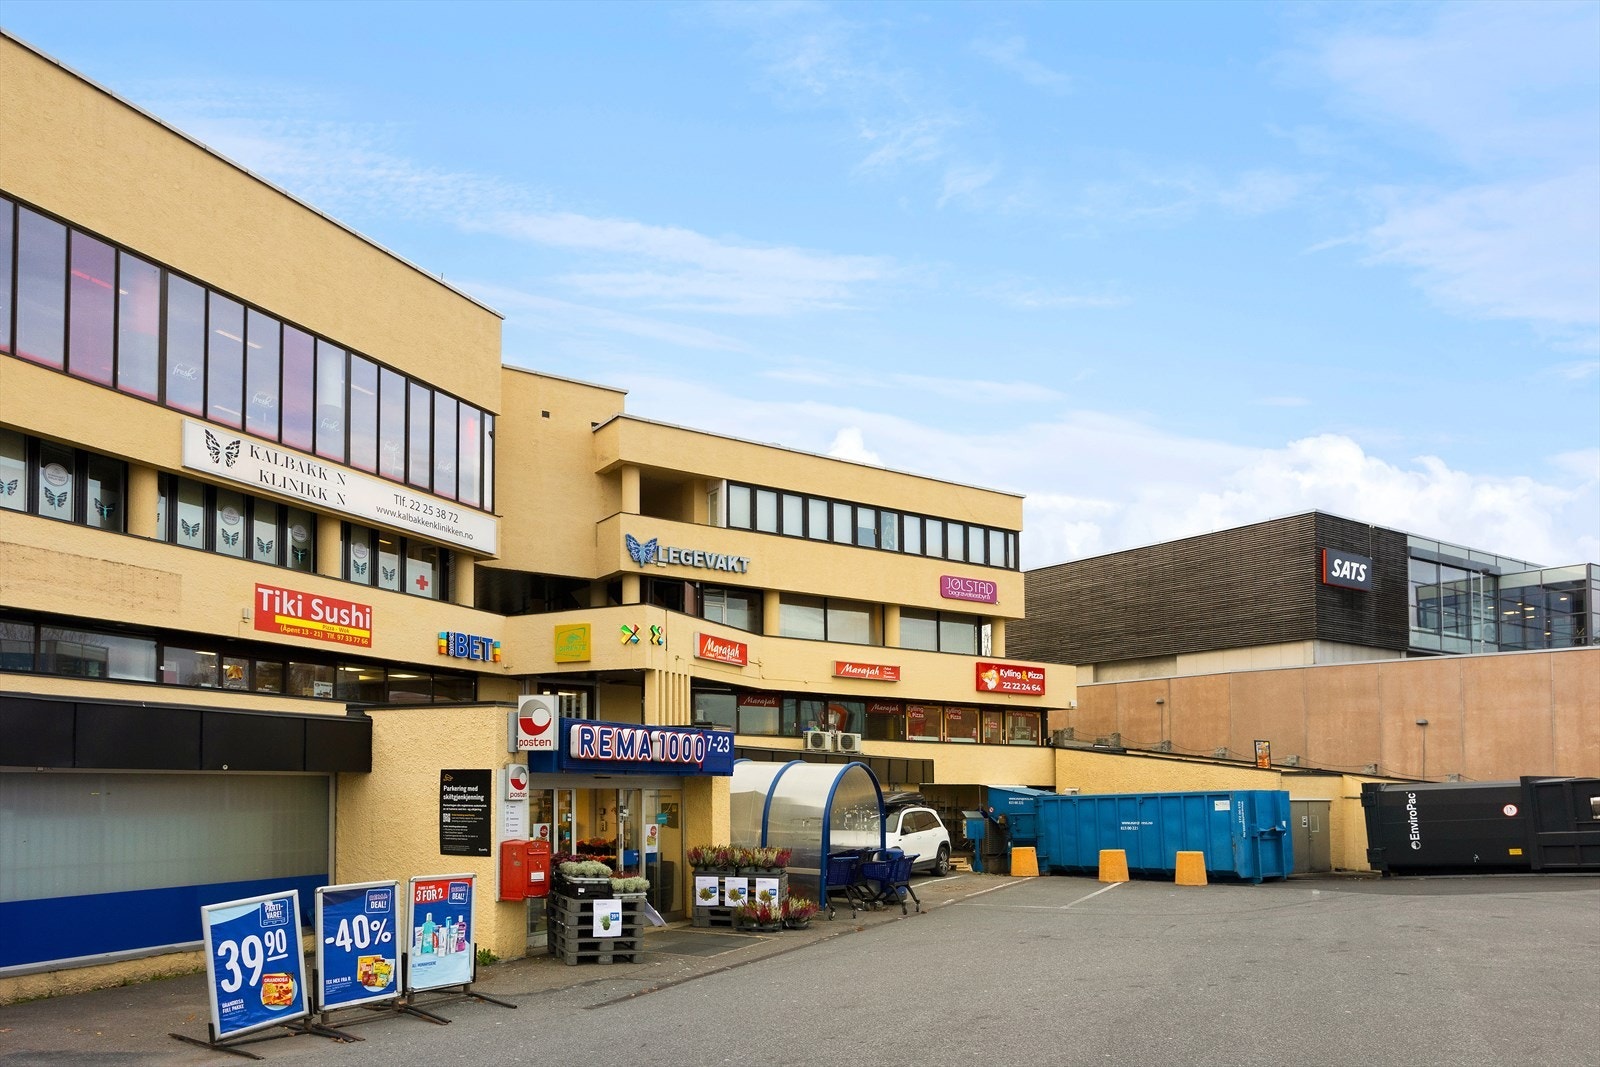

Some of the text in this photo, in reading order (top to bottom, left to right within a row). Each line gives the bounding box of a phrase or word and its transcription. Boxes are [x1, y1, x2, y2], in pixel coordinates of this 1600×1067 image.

[394, 494, 459, 524] Tlf. 22 25 38 72
[375, 505, 474, 541] www.kalbakkenklinikken.no
[656, 545, 751, 574] LEGEVAKT
[1331, 558, 1368, 582] SATS
[946, 577, 994, 595] JØLSTAD
[257, 587, 371, 629] Tiki Sushi
[454, 632, 494, 662] BET
[702, 637, 740, 658] Marajah
[840, 663, 880, 677] Marajah
[1000, 669, 1044, 682] Kylling & Pizza
[1002, 682, 1041, 692] 22 22 24 64
[518, 737, 552, 748] posten
[578, 724, 730, 763] REMA 1000 7-23
[443, 784, 467, 793] Parkering
[509, 791, 527, 799] posten
[1406, 791, 1421, 841] EnviroPac
[415, 887, 444, 902] 3 FOR 2
[451, 892, 465, 900] DEAL!
[264, 903, 284, 913] PARTI-
[370, 900, 387, 909] DEAL!
[266, 909, 282, 919] VARE!
[324, 914, 392, 953] -40%
[217, 928, 287, 993] 39 90
